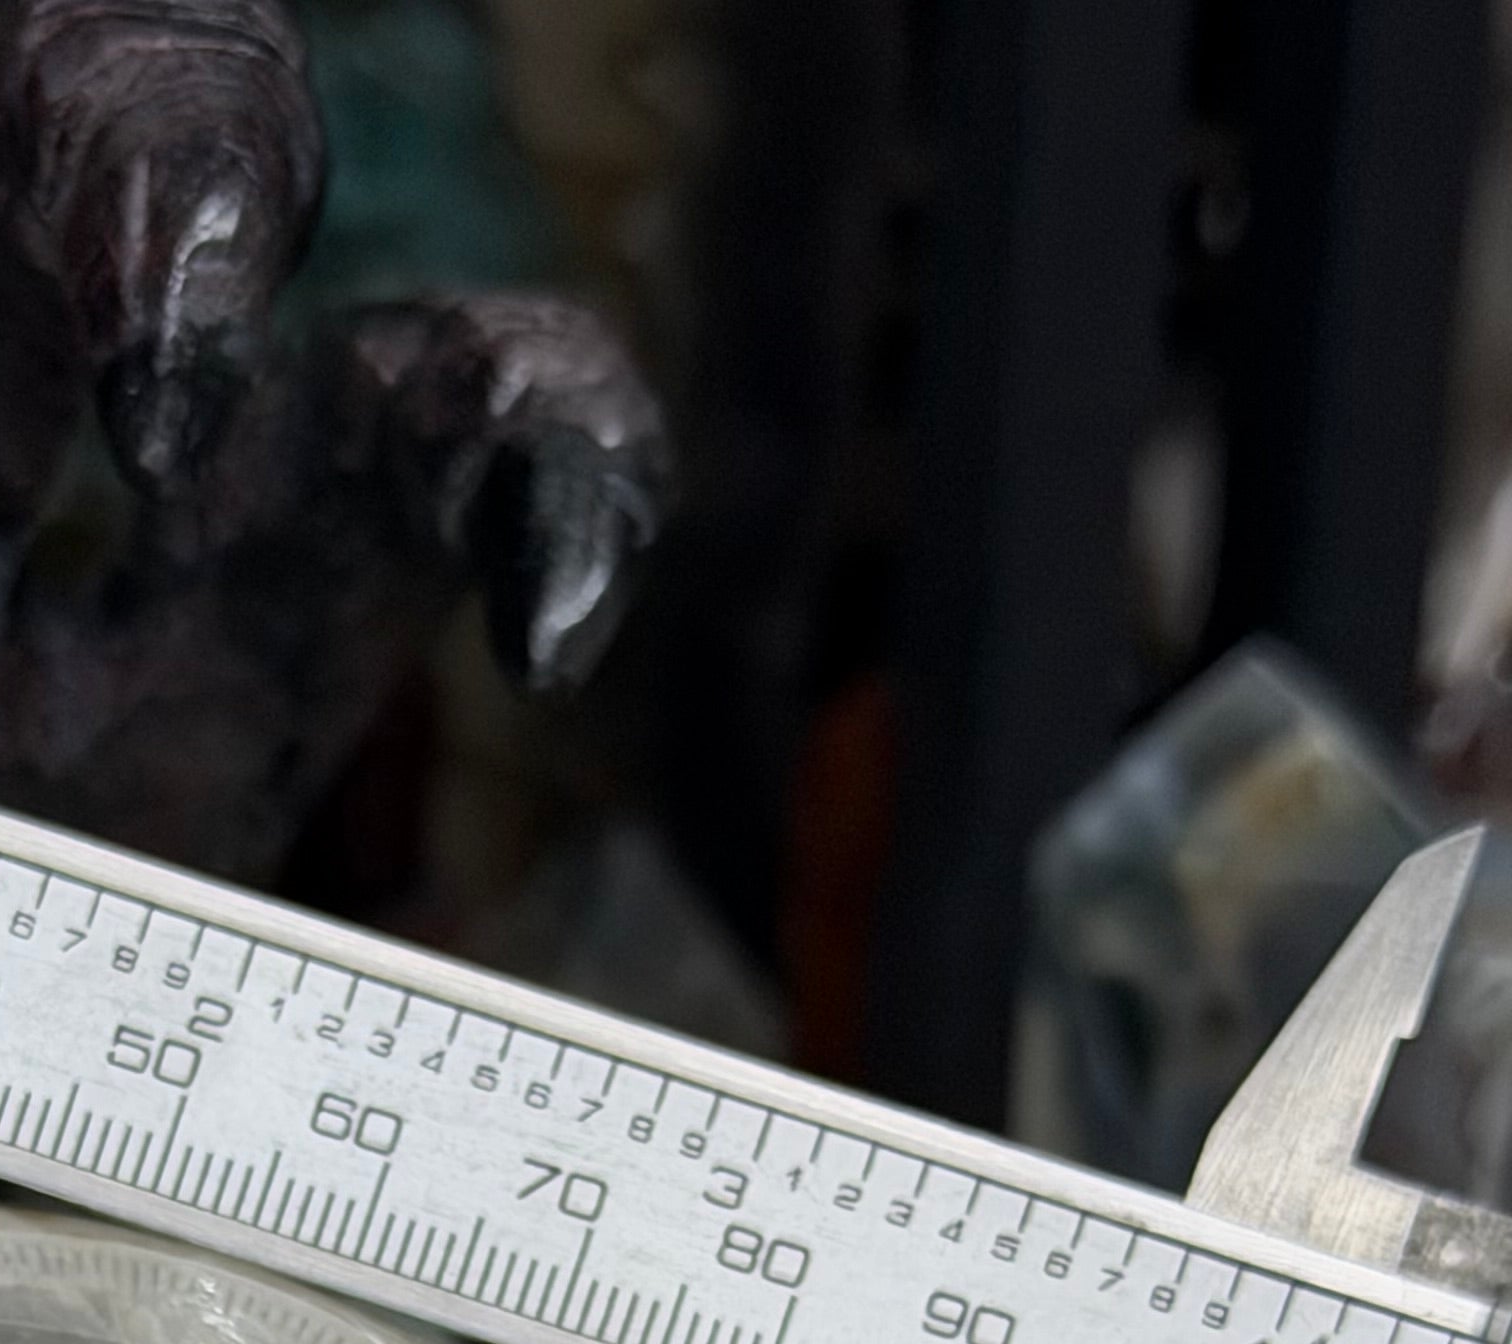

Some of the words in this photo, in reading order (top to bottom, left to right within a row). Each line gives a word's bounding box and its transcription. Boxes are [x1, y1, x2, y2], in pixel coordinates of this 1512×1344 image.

[8, 910, 36, 940] 6
[61, 927, 87, 952] 7
[111, 944, 139, 974] 8
[162, 961, 191, 990] 9
[187, 996, 234, 1043] 2
[270, 997, 285, 1022] 1
[316, 1013, 346, 1043] 2
[366, 1030, 396, 1058] 3
[420, 1049, 446, 1074] 4
[470, 1064, 500, 1092] 5
[524, 1081, 552, 1110] 6
[576, 1099, 604, 1122] 7
[627, 1114, 656, 1144] 8
[679, 1131, 707, 1160] 9
[702, 1165, 750, 1210] 3
[786, 1166, 803, 1192] 1
[833, 1183, 863, 1211] 2
[885, 1199, 915, 1228] 3
[939, 1219, 966, 1243] 4
[990, 1234, 1021, 1262] 5
[1043, 1250, 1073, 1279] 6
[1098, 1268, 1125, 1291] 7
[1149, 1285, 1177, 1313] 8
[1202, 1301, 1230, 1330] 9
[106, 1024, 203, 1090] 50
[309, 1091, 405, 1157] 60
[516, 1156, 609, 1223] 70
[715, 1222, 812, 1289] 80
